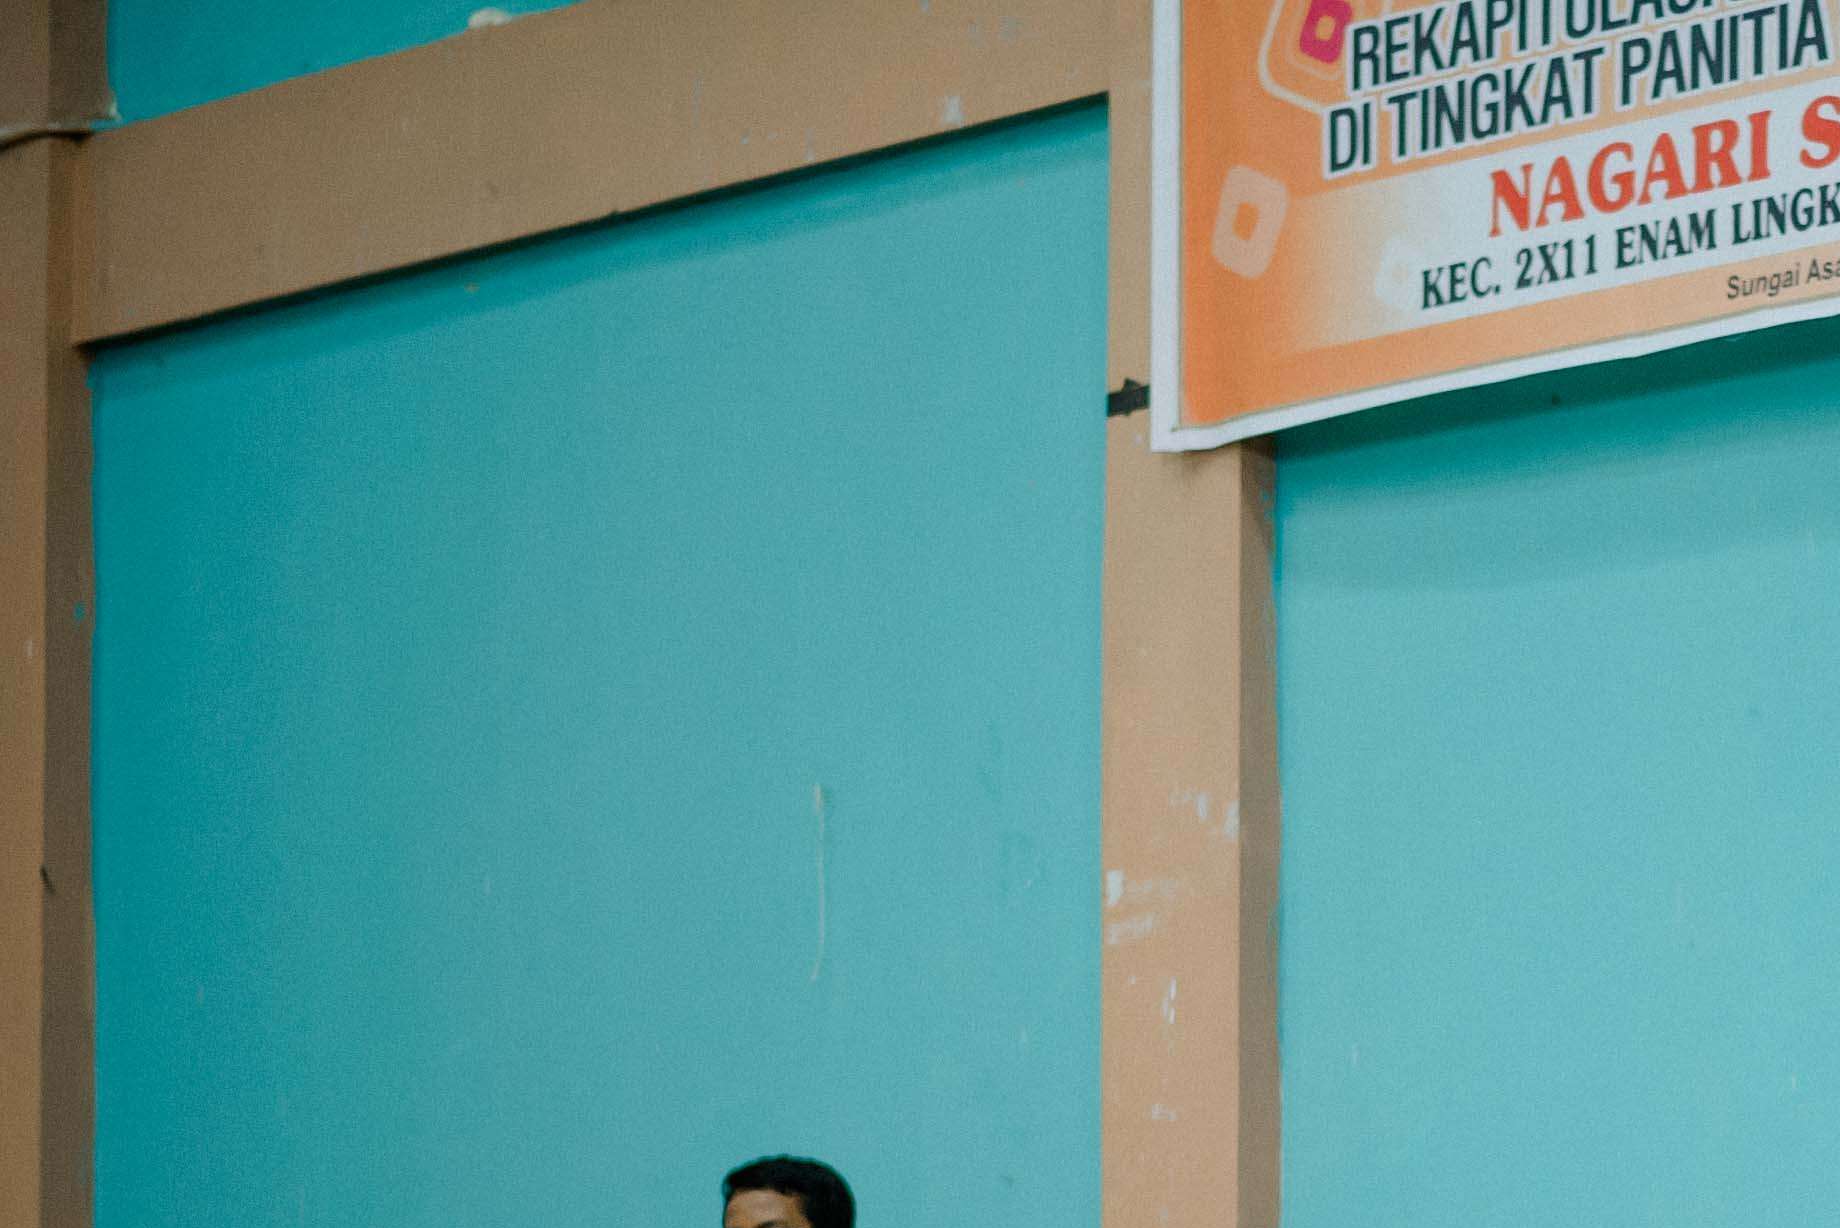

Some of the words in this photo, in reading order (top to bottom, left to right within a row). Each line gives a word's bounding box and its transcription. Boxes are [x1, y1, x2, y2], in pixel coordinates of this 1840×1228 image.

[1329, 101, 1371, 173] DI
[1388, 47, 1604, 157] TINGKAT
[1620, 0, 1829, 106] PANITIA
[1352, 0, 1714, 91] REKAPITUL
[1489, 109, 1773, 237] NAGARI
[1421, 256, 1501, 310] KEC.
[1515, 233, 1600, 290] 2X11
[1615, 208, 1717, 269] ENAM
[1726, 262, 1801, 301] Sungai
